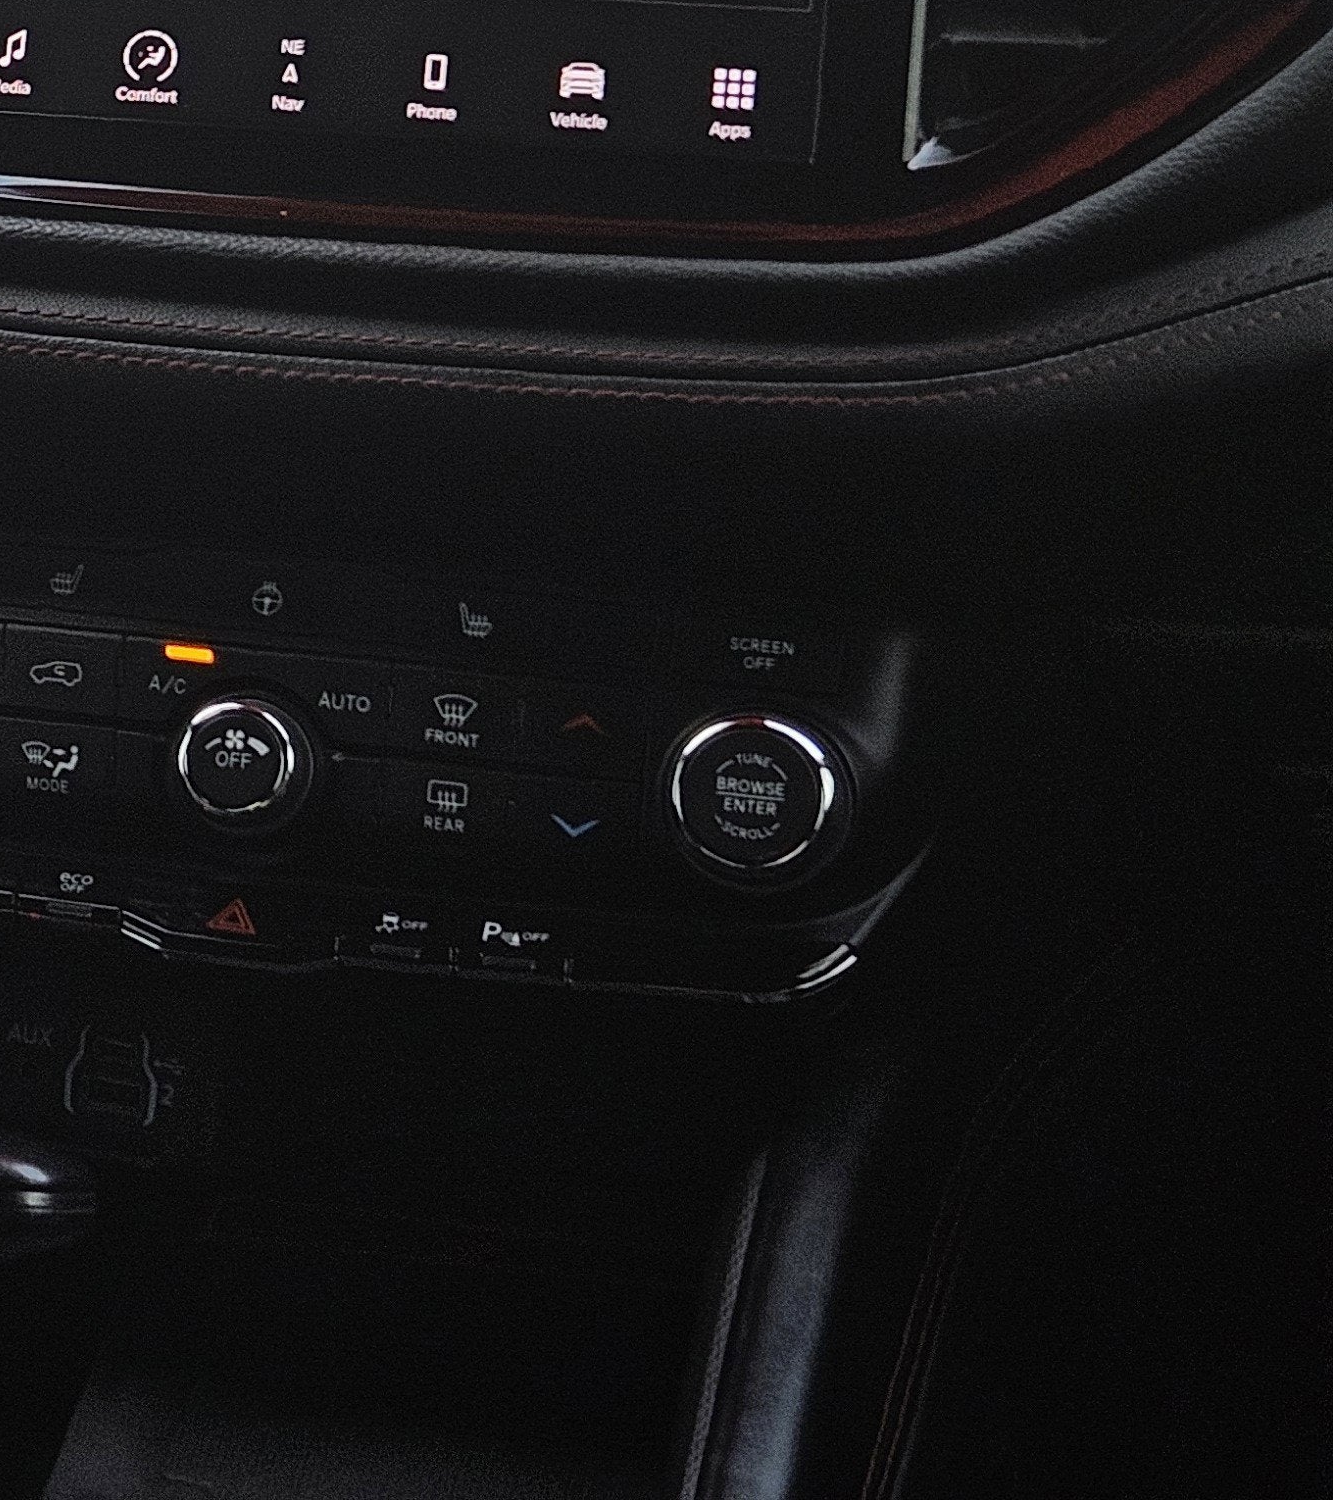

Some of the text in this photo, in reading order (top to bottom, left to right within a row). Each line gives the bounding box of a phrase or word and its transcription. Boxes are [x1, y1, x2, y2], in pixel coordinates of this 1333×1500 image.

[280, 39, 305, 55] NE
[115, 86, 178, 105] Comfort
[271, 95, 305, 112] Nav
[406, 102, 457, 122] Phone
[550, 110, 608, 131] Vehicle
[708, 120, 752, 142] Apps
[730, 637, 795, 656] SCREEN
[743, 657, 776, 670] OFF
[148, 674, 188, 695] A/C
[318, 692, 371, 713] AUTO
[425, 728, 480, 748] FRONT
[215, 750, 252, 769] OFF
[26, 776, 70, 794] MODE
[716, 775, 785, 796] BROWSE
[723, 800, 777, 817] ENTER
[424, 816, 465, 833] REAR
